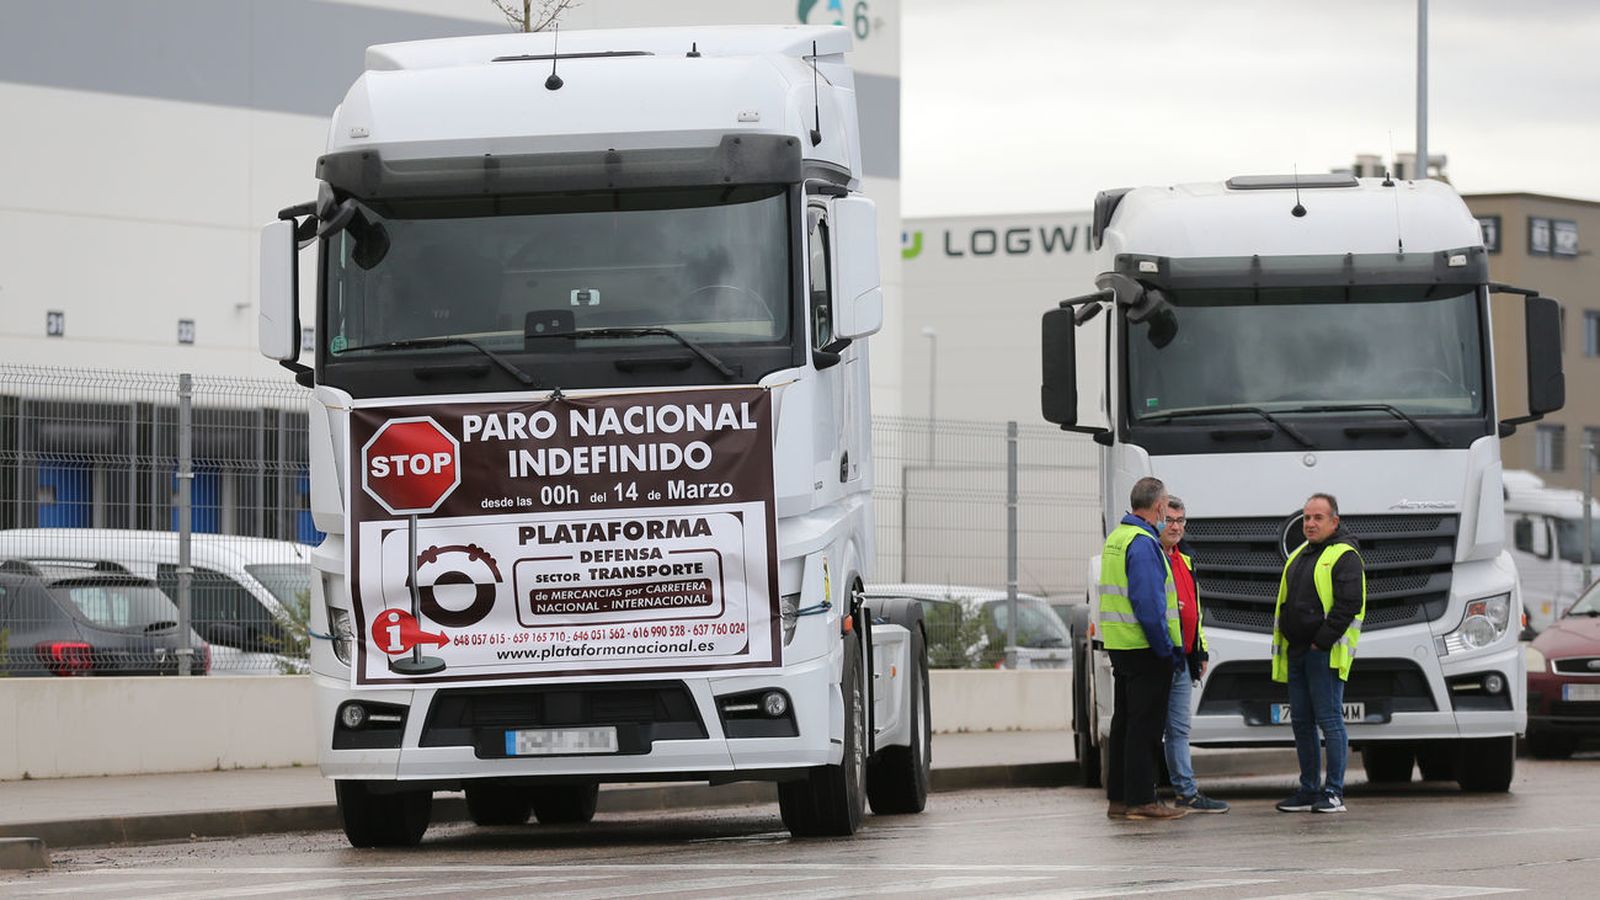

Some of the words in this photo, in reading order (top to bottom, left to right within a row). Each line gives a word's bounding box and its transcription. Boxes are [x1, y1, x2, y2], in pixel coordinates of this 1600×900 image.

[945, 225, 1092, 257] LOGWI
[462, 410, 557, 442] PARO
[569, 402, 757, 437] NACIONAL
[370, 452, 451, 478] STOP
[508, 440, 713, 478] INDEFINIDO
[481, 497, 514, 509] desde
[516, 496, 533, 507] las
[540, 484, 579, 506] 00h
[590, 492, 607, 503] del
[613, 481, 639, 502] 14
[647, 490, 661, 501] de
[667, 479, 734, 500] Marzo
[518, 517, 712, 546] PLATAFORMA
[580, 547, 663, 563] DEFENSA
[535, 573, 581, 583] SECTOR
[588, 563, 704, 581] TRANSPORTE
[535, 592, 548, 601] de
[550, 588, 623, 601] MERCANCIAS
[625, 587, 643, 598] por
[645, 581, 707, 594] CARRETERA
[537, 600, 600, 613] NACIONAL
[611, 594, 708, 610] INTERNACIONAL
[453, 635, 469, 646] 648
[471, 634, 488, 646] 057
[490, 633, 505, 645] 615
[513, 633, 529, 644] 659
[532, 632, 547, 642] 165
[550, 631, 566, 642] 710
[573, 629, 589, 641] 646
[591, 628, 606, 641] 051
[609, 628, 625, 640] 562
[632, 626, 649, 639] 616
[651, 625, 667, 638] 990
[670, 625, 686, 637] 528
[693, 624, 709, 636] 637
[712, 623, 727, 635] 760
[729, 622, 746, 635] 024
[497, 640, 715, 661] www.plataformanacional.es
[1342, 705, 1361, 720] MM
